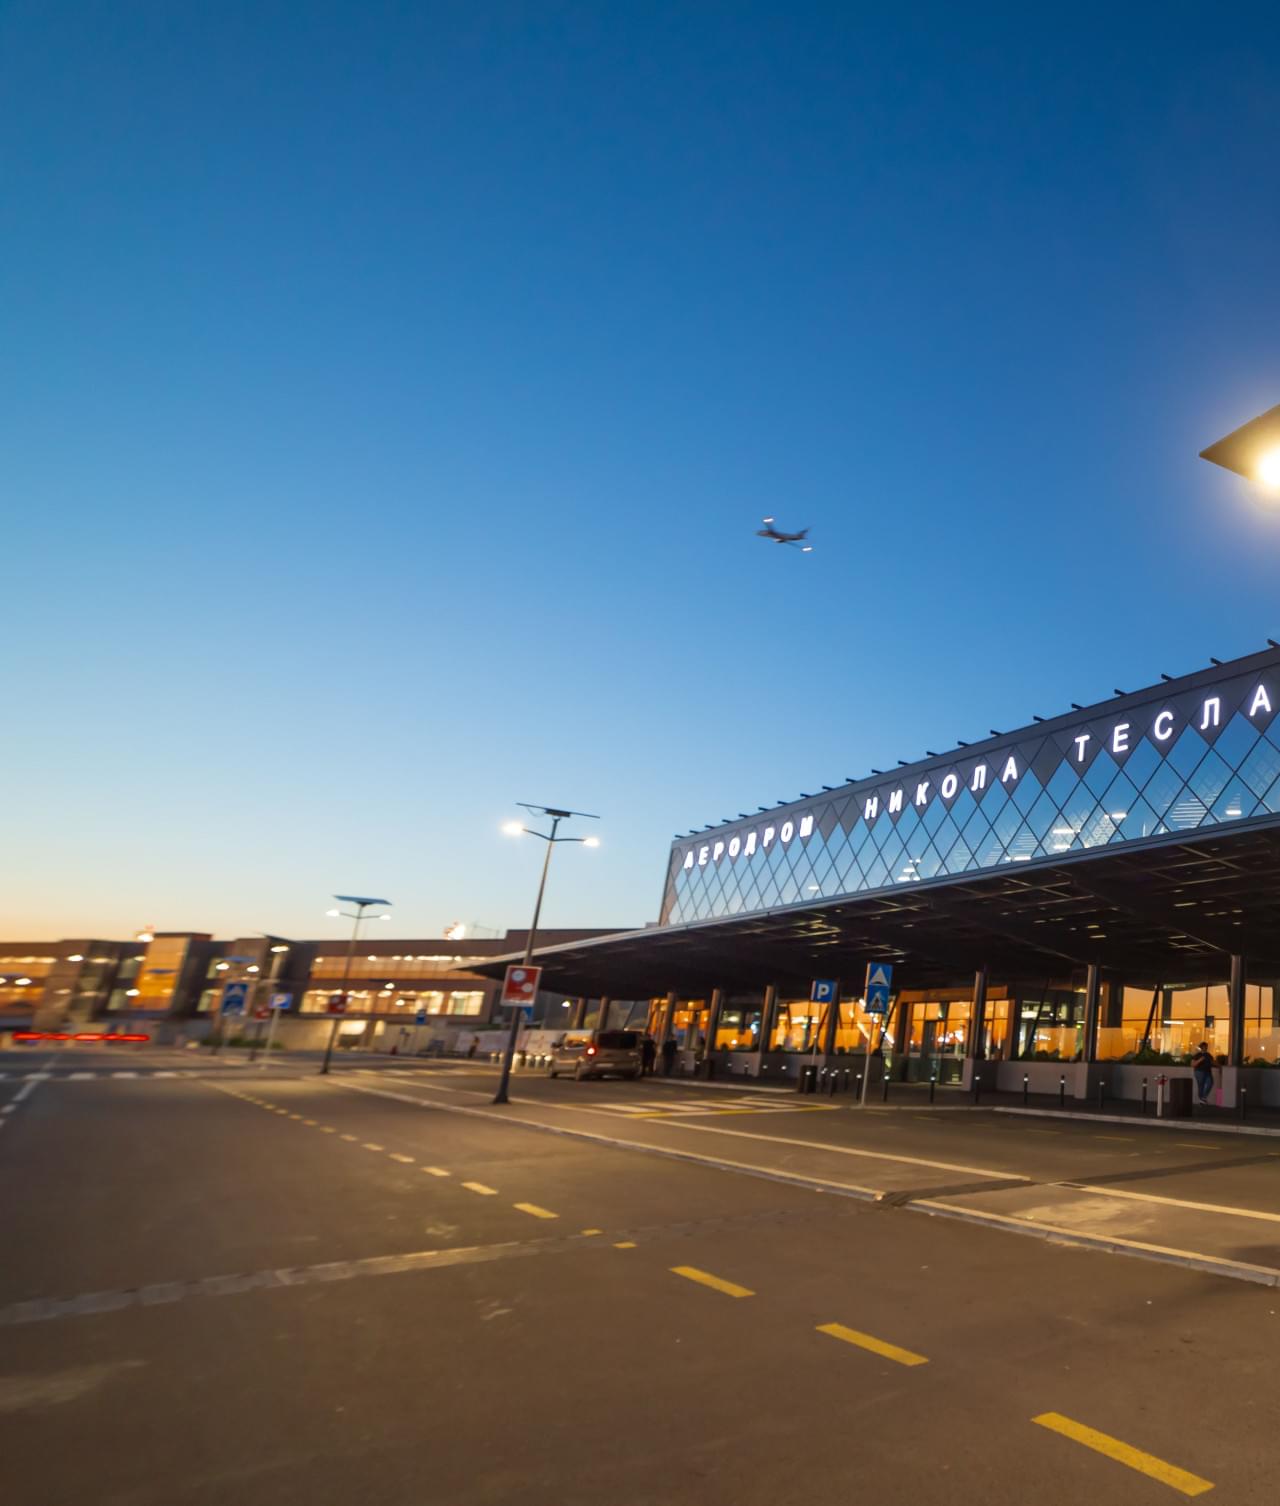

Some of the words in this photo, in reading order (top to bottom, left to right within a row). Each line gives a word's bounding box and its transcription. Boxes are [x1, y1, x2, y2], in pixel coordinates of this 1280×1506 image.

[683, 814, 815, 869] АЕРОДРОМ
[864, 756, 1018, 820] НИКОЛА
[1074, 684, 1272, 762] ТЕСЛА
[816, 983, 830, 999] P
